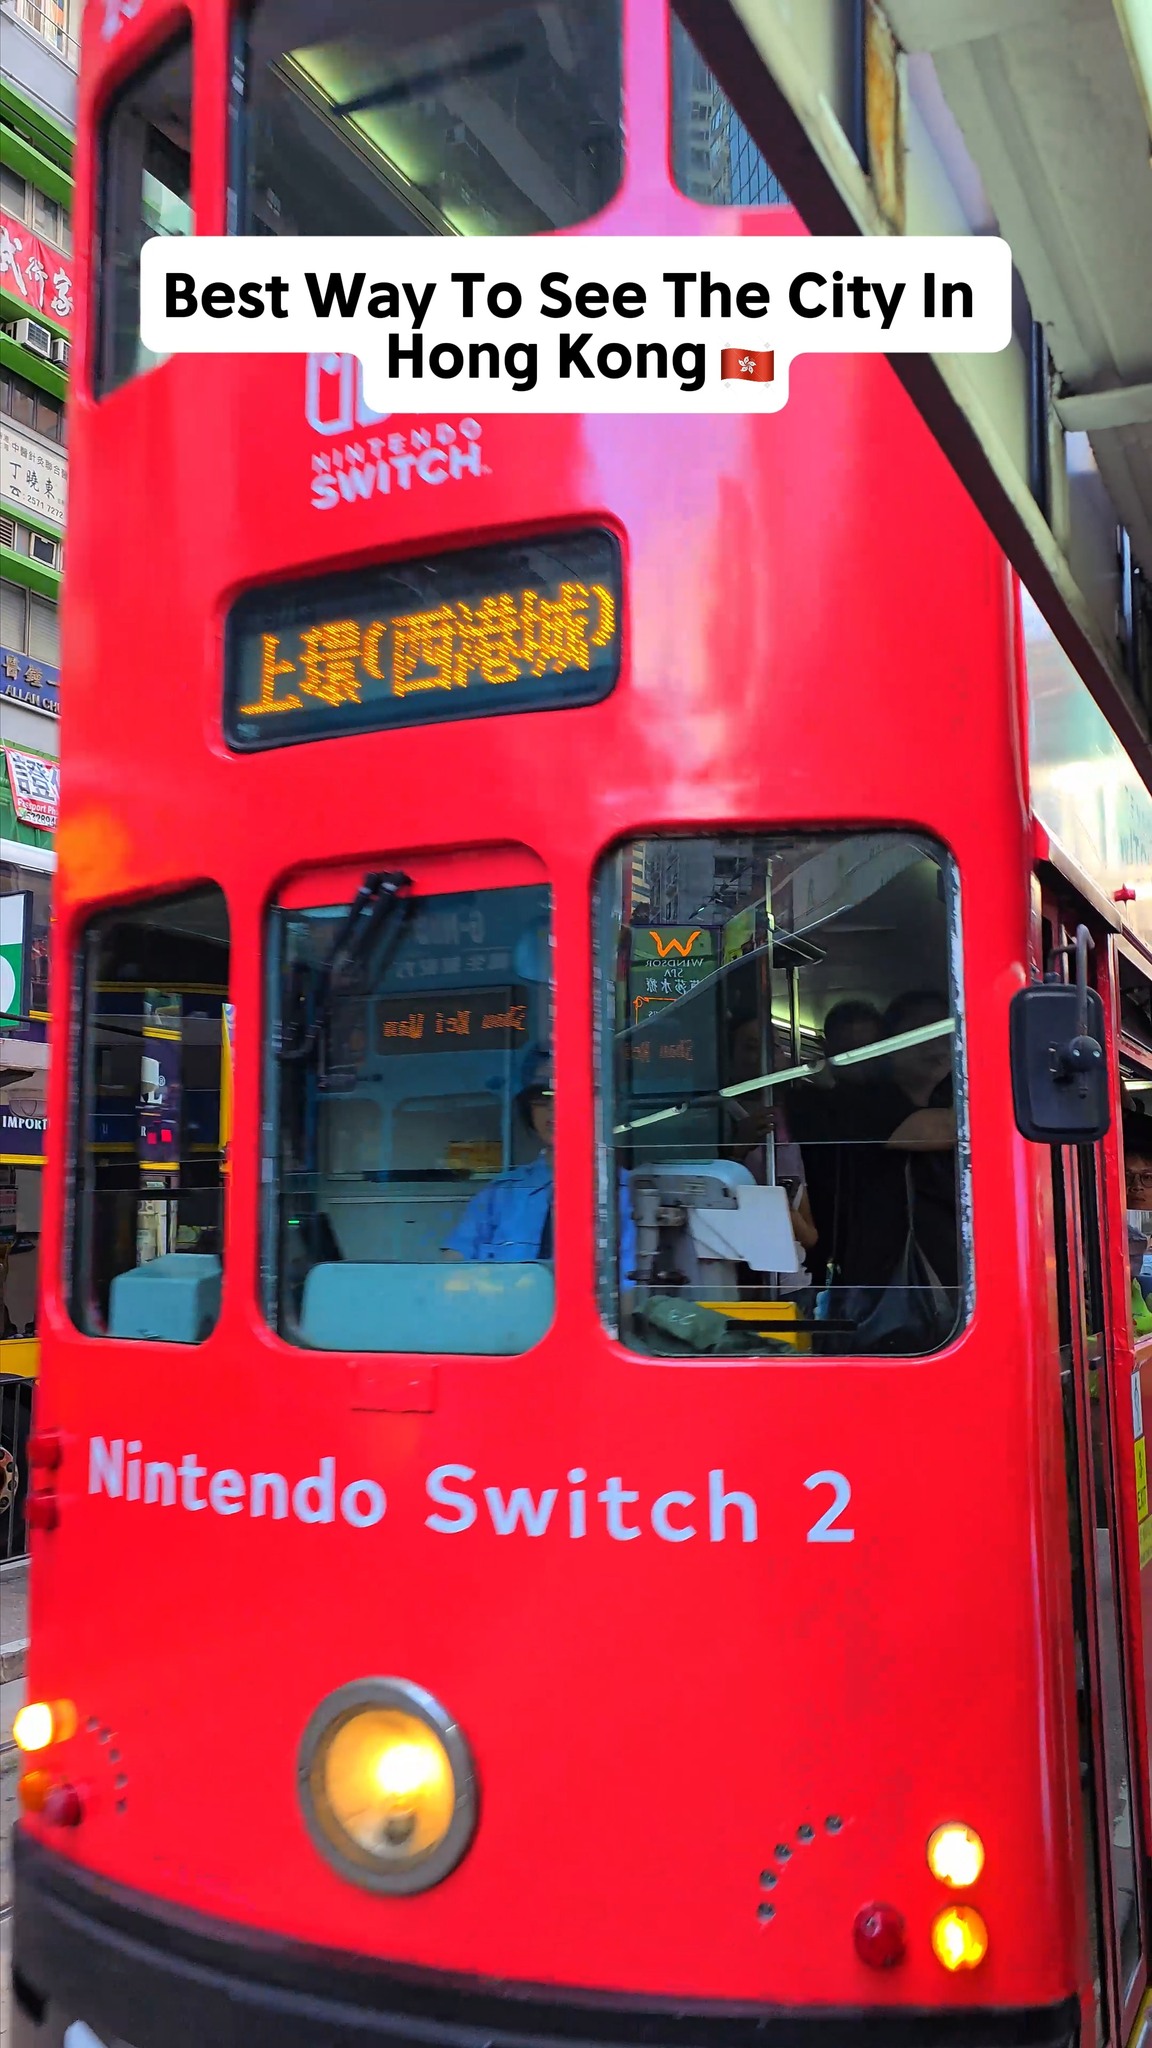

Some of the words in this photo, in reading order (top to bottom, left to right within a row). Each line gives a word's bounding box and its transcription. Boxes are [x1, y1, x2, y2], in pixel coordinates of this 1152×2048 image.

[311, 417, 482, 474] NINTENDO
[241, 583, 615, 715] 上環(西港城)
[5, 684, 40, 706] ALLAN
[89, 1437, 386, 1528] Nintendo
[425, 1464, 757, 1543] Switch
[804, 1470, 855, 1543] 2
